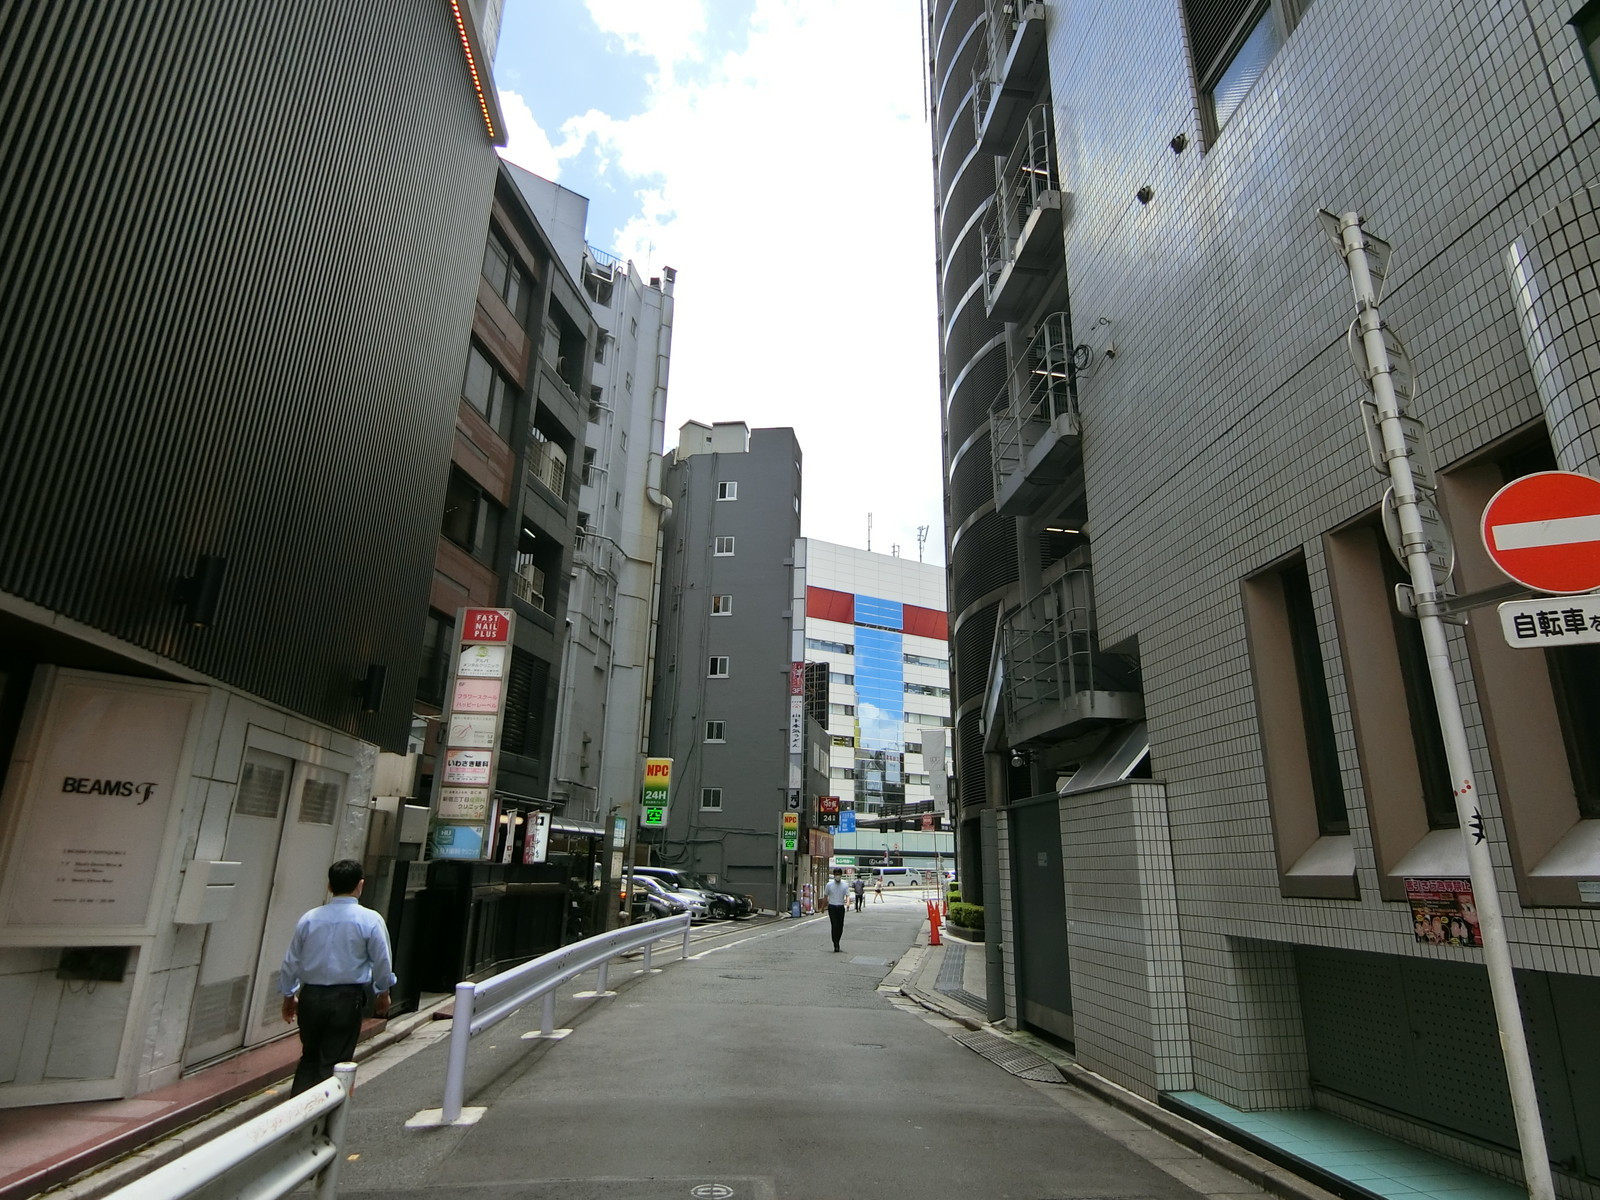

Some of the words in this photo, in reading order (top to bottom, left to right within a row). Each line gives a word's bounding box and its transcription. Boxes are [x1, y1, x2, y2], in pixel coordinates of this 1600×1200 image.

[476, 614, 499, 622] FAST
[474, 630, 497, 638] PLUS
[447, 759, 489, 767] いわさき眼科
[647, 764, 669, 776] NPC
[61, 776, 134, 797] BEAMS
[645, 790, 667, 800] 24H
[646, 807, 663, 824] 空
